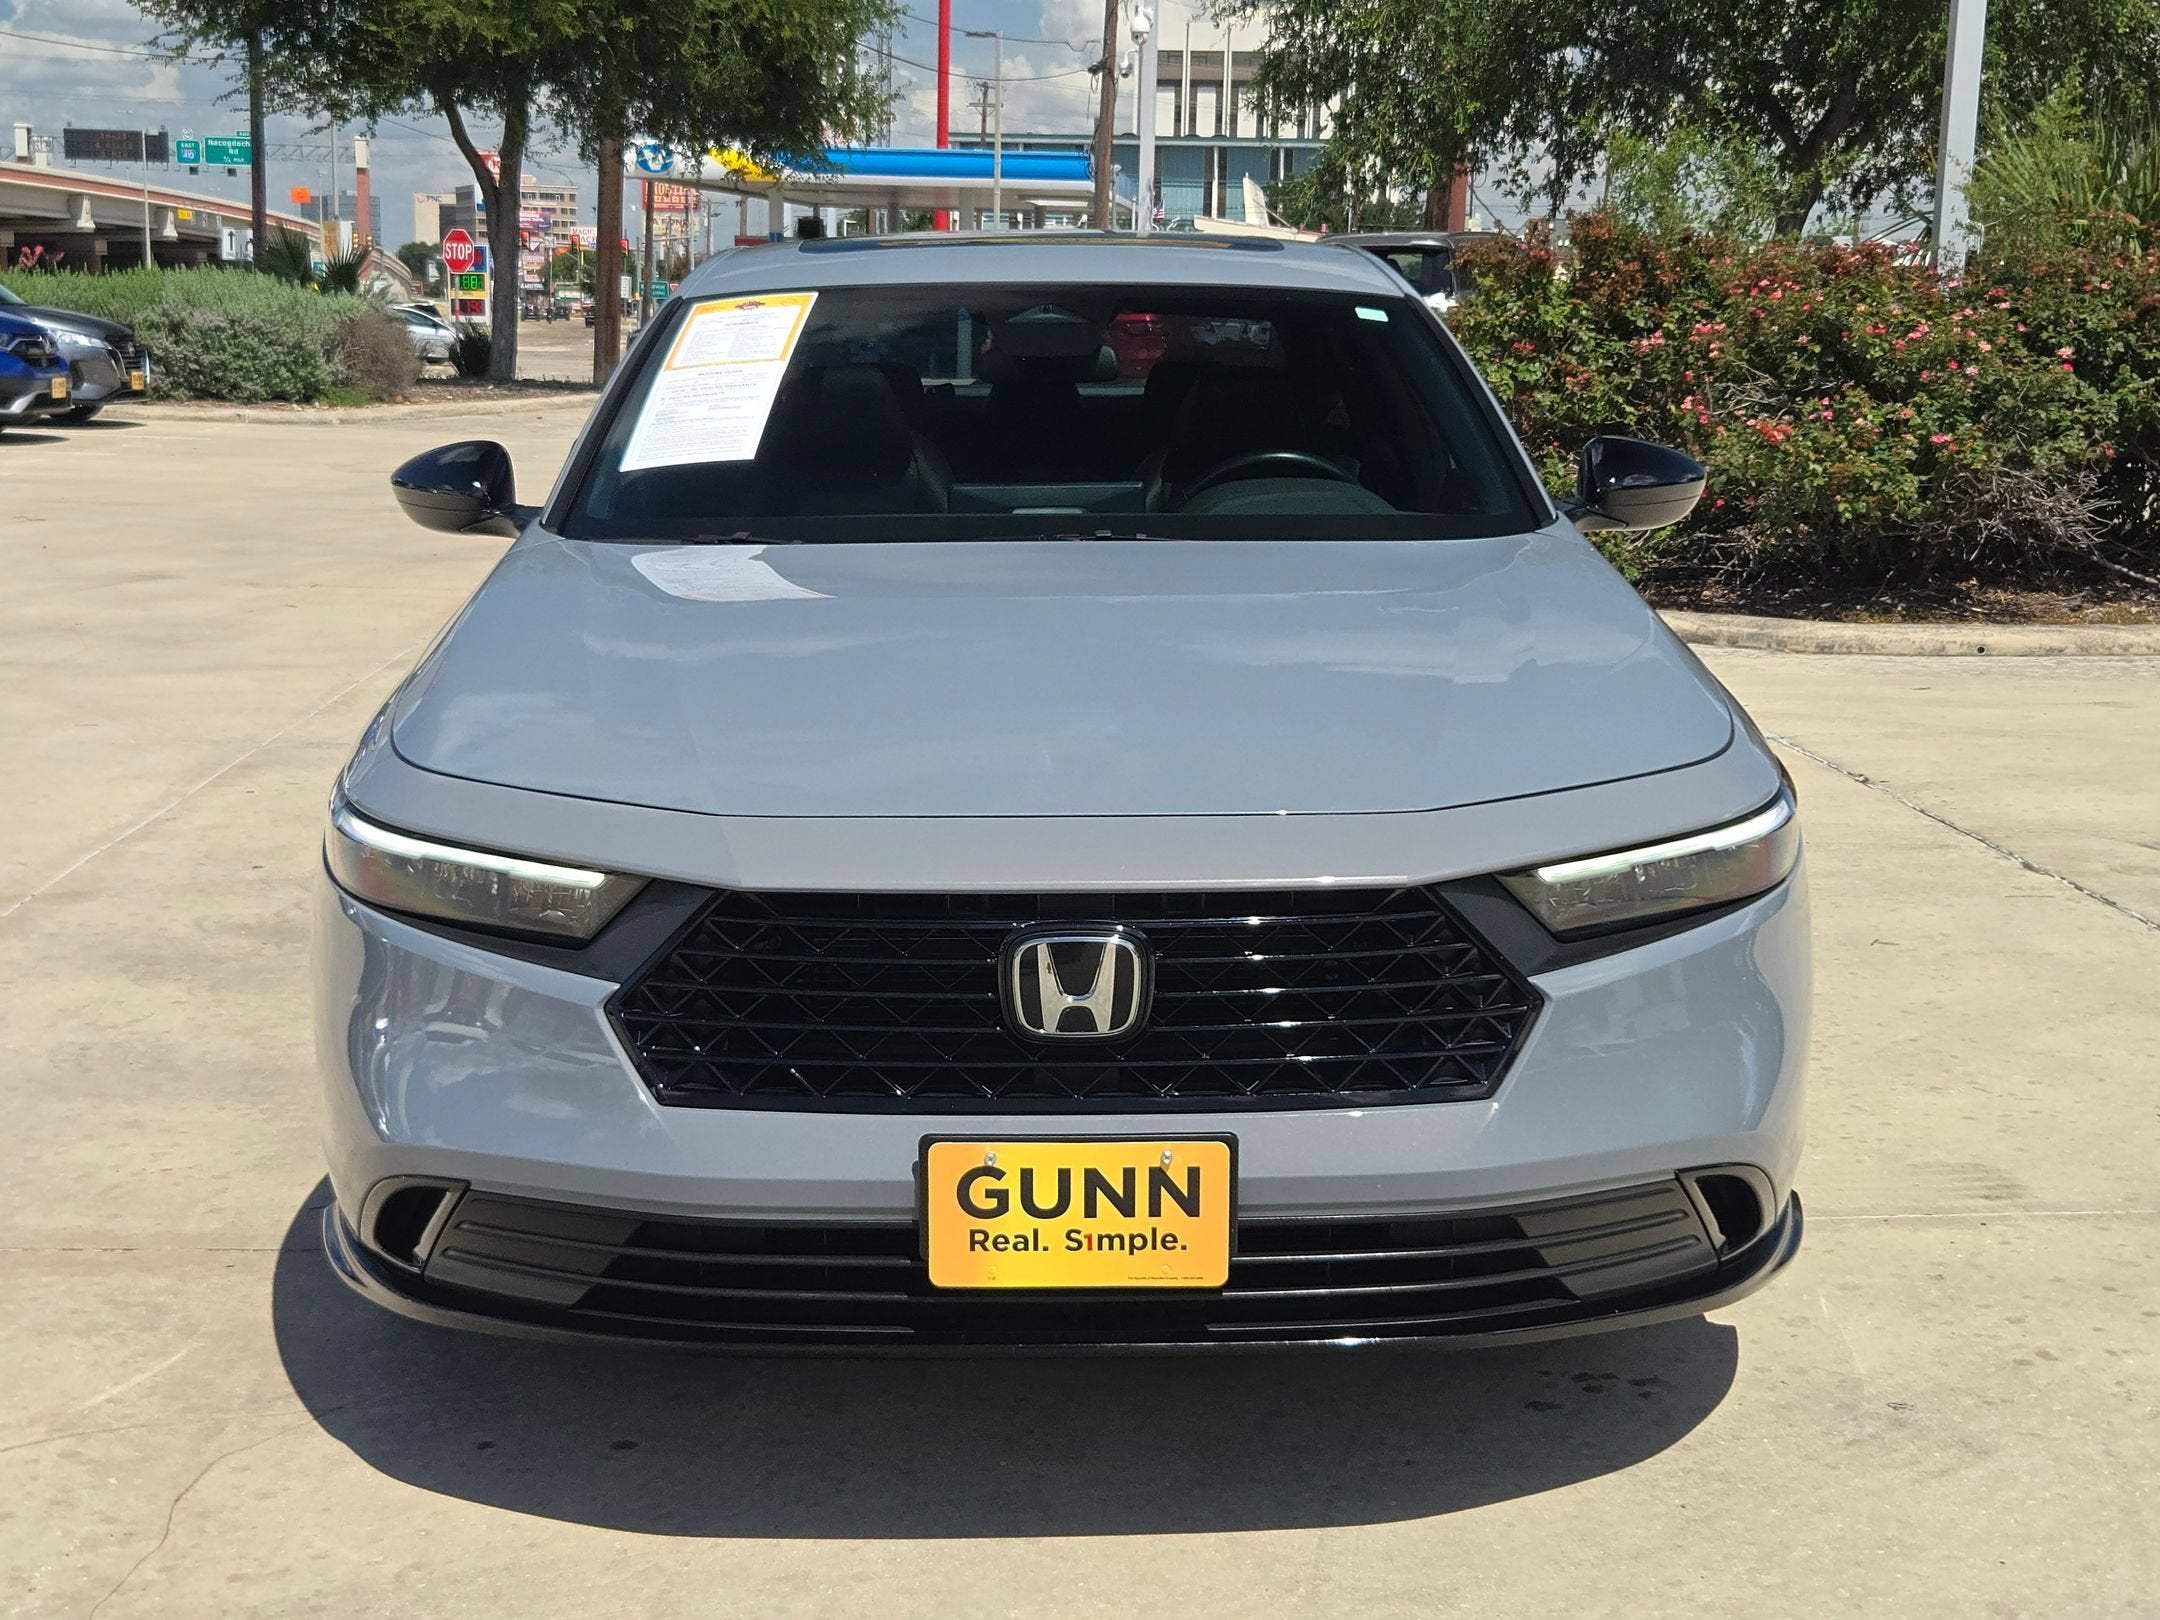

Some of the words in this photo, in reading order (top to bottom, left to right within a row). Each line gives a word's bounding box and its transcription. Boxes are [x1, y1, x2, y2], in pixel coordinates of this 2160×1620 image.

[207, 140, 251, 148] Nacogdoch
[445, 243, 472, 260] STOP
[956, 1165, 1201, 1220] GUNN
[969, 1228, 1049, 1252] Real.
